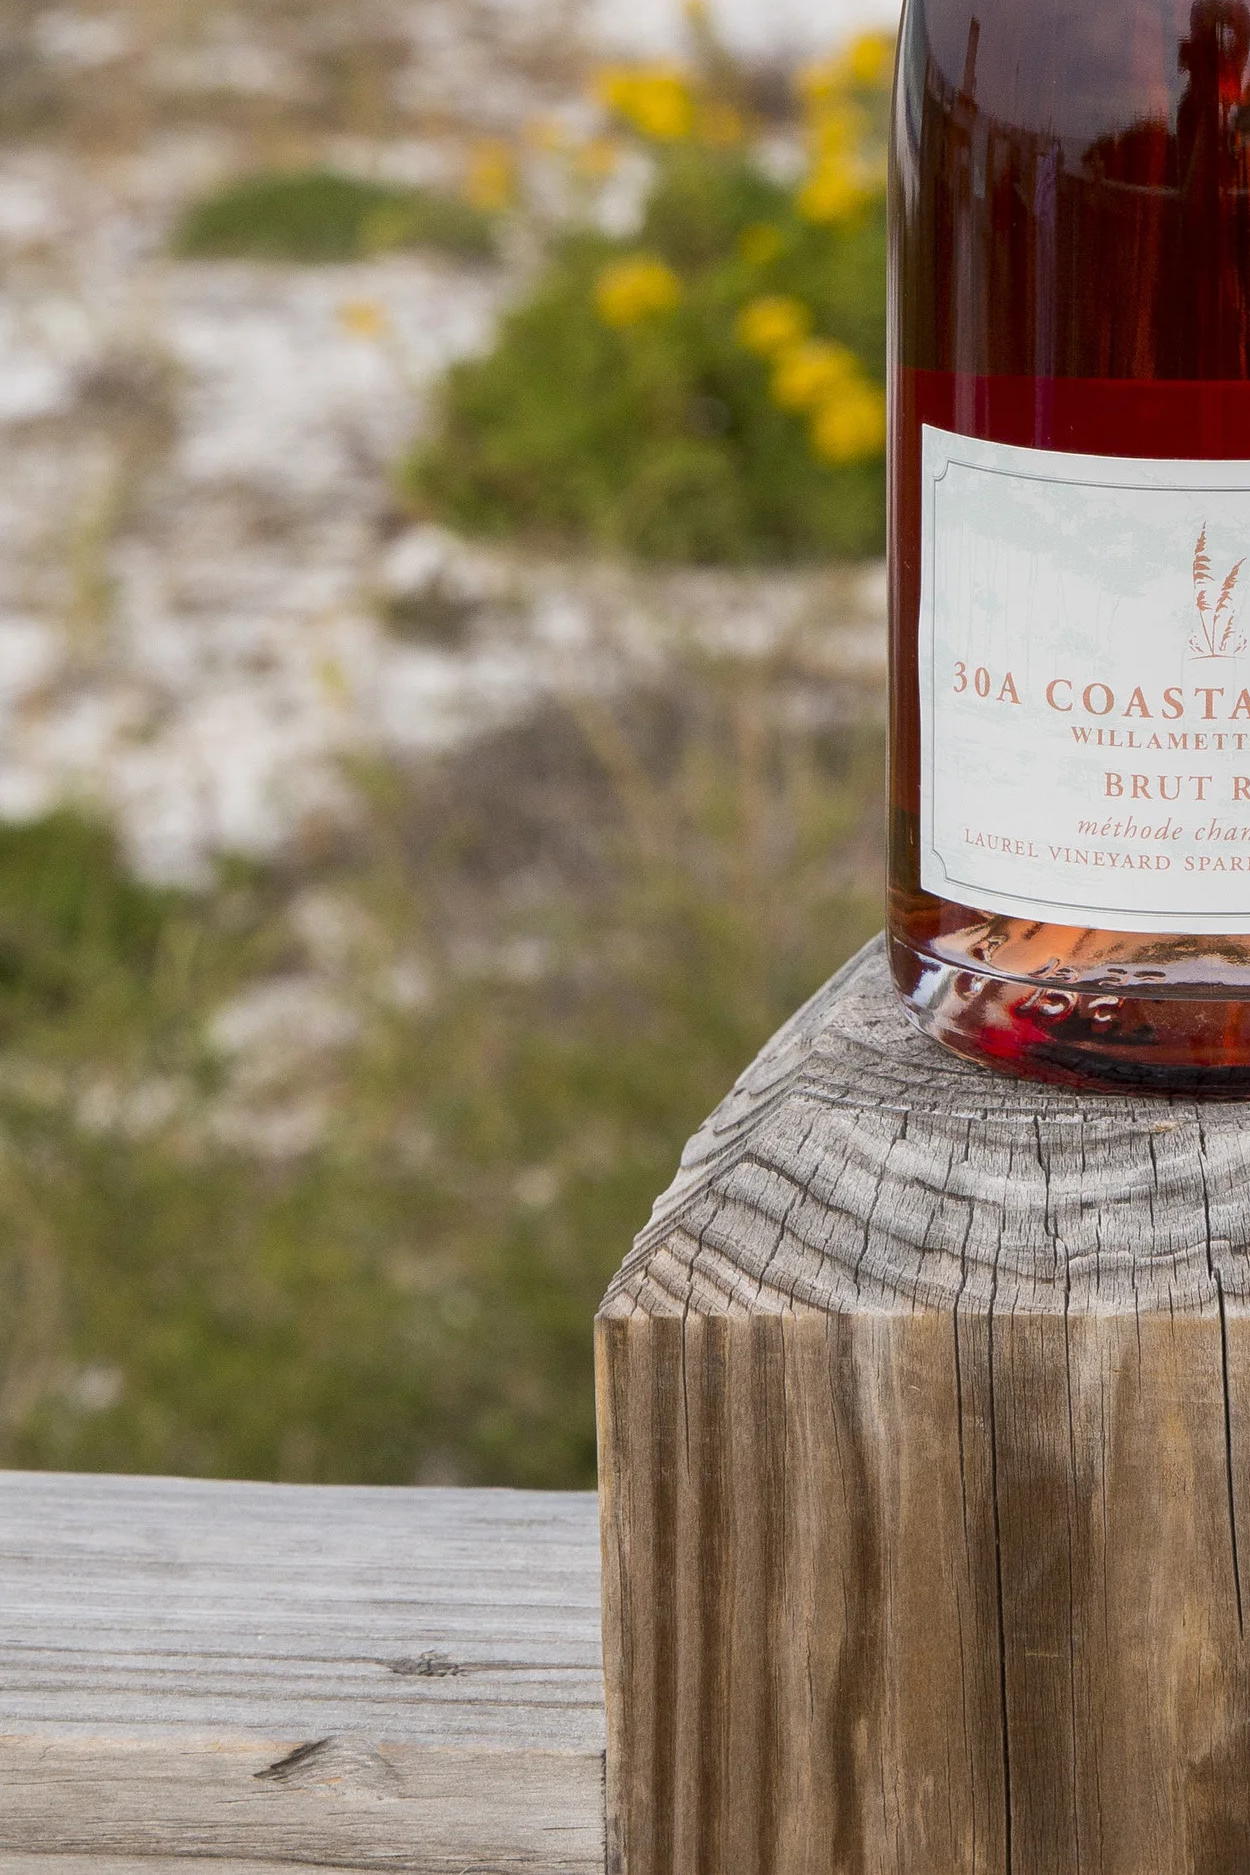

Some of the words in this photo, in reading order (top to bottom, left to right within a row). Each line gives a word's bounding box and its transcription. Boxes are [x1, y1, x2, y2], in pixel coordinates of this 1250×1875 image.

[953, 661, 1022, 705] 30A
[1104, 772, 1213, 801] BRUT
[1078, 816, 1183, 841] méthode
[964, 828, 1039, 858] LAUREL
[1049, 845, 1171, 871] VINEYARD
